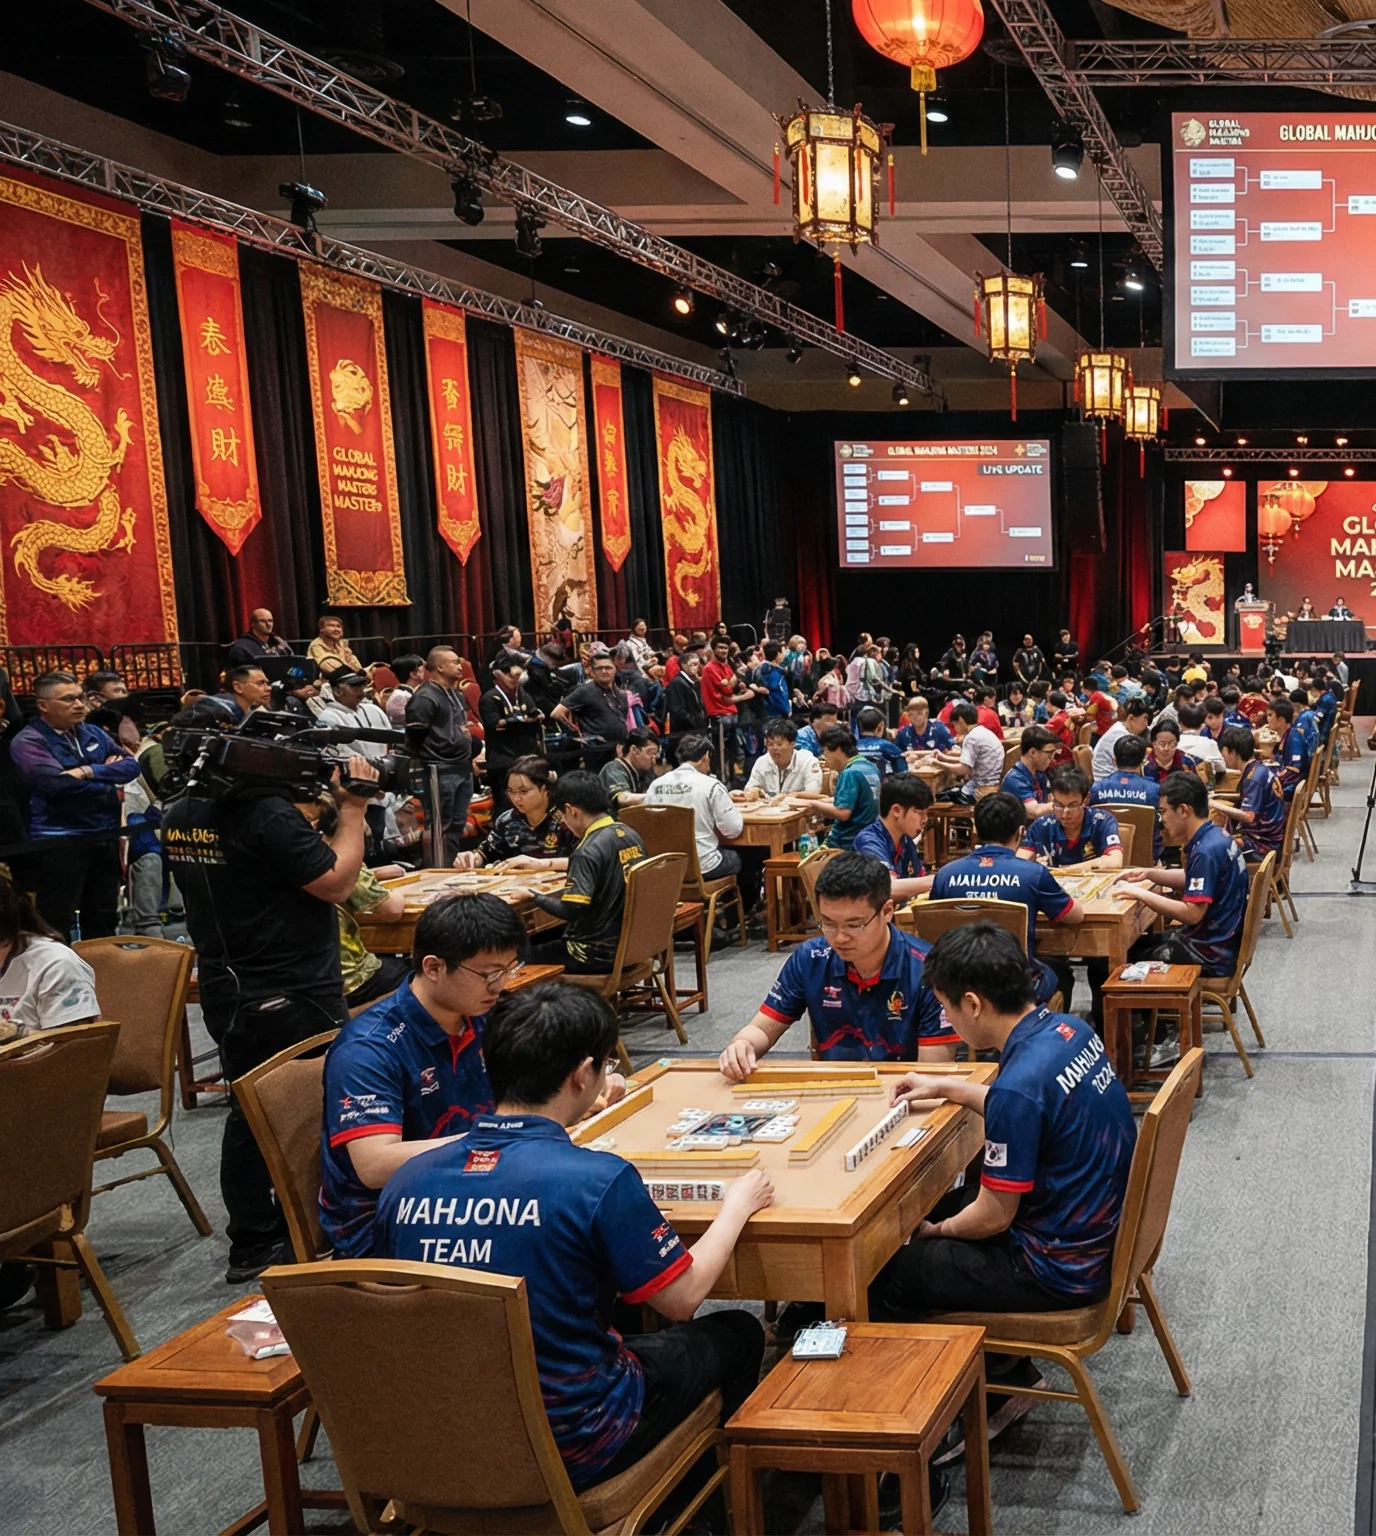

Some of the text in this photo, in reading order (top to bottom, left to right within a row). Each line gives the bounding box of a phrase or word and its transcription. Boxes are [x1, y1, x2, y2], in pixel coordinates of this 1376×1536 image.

[1279, 124, 1332, 141] GLOBAL
[396, 1197, 541, 1227] MAHJONA
[419, 1238, 492, 1264] TEAM
